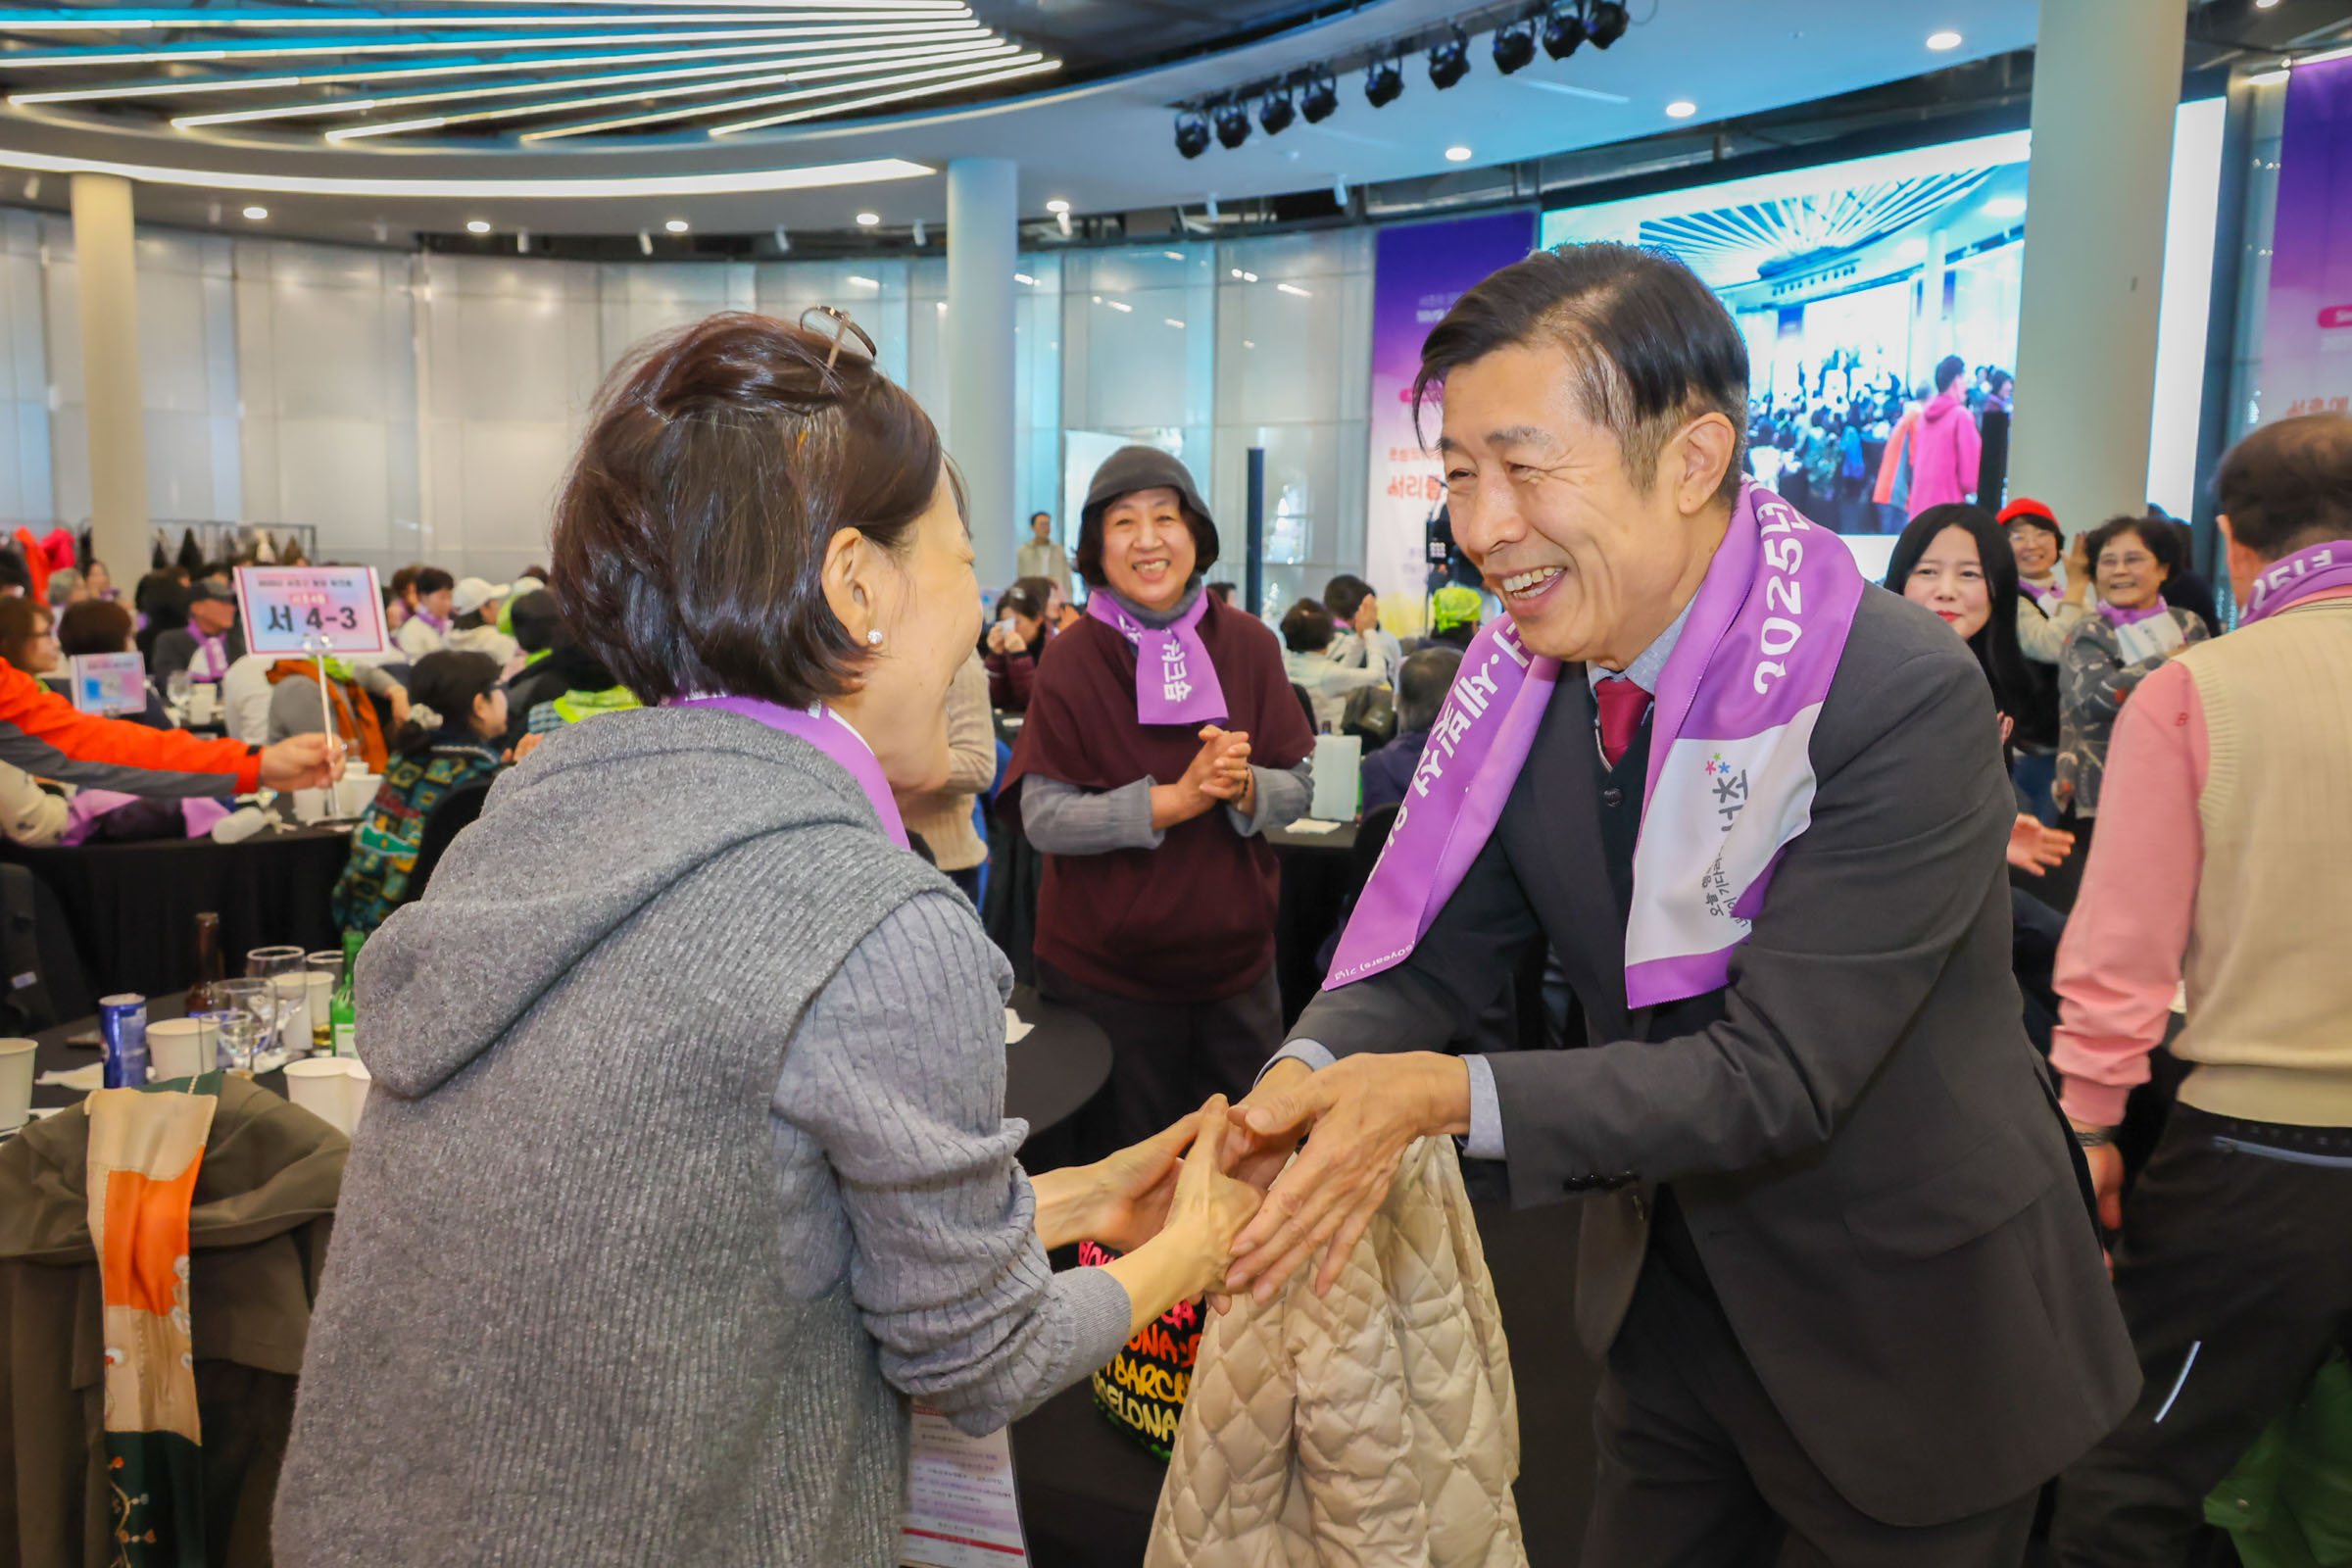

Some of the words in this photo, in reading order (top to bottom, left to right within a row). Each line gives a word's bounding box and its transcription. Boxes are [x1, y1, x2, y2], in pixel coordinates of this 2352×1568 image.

[269, 605, 293, 632] 서
[306, 606, 357, 630] 4-3
[1753, 502, 1811, 695] 2025년
